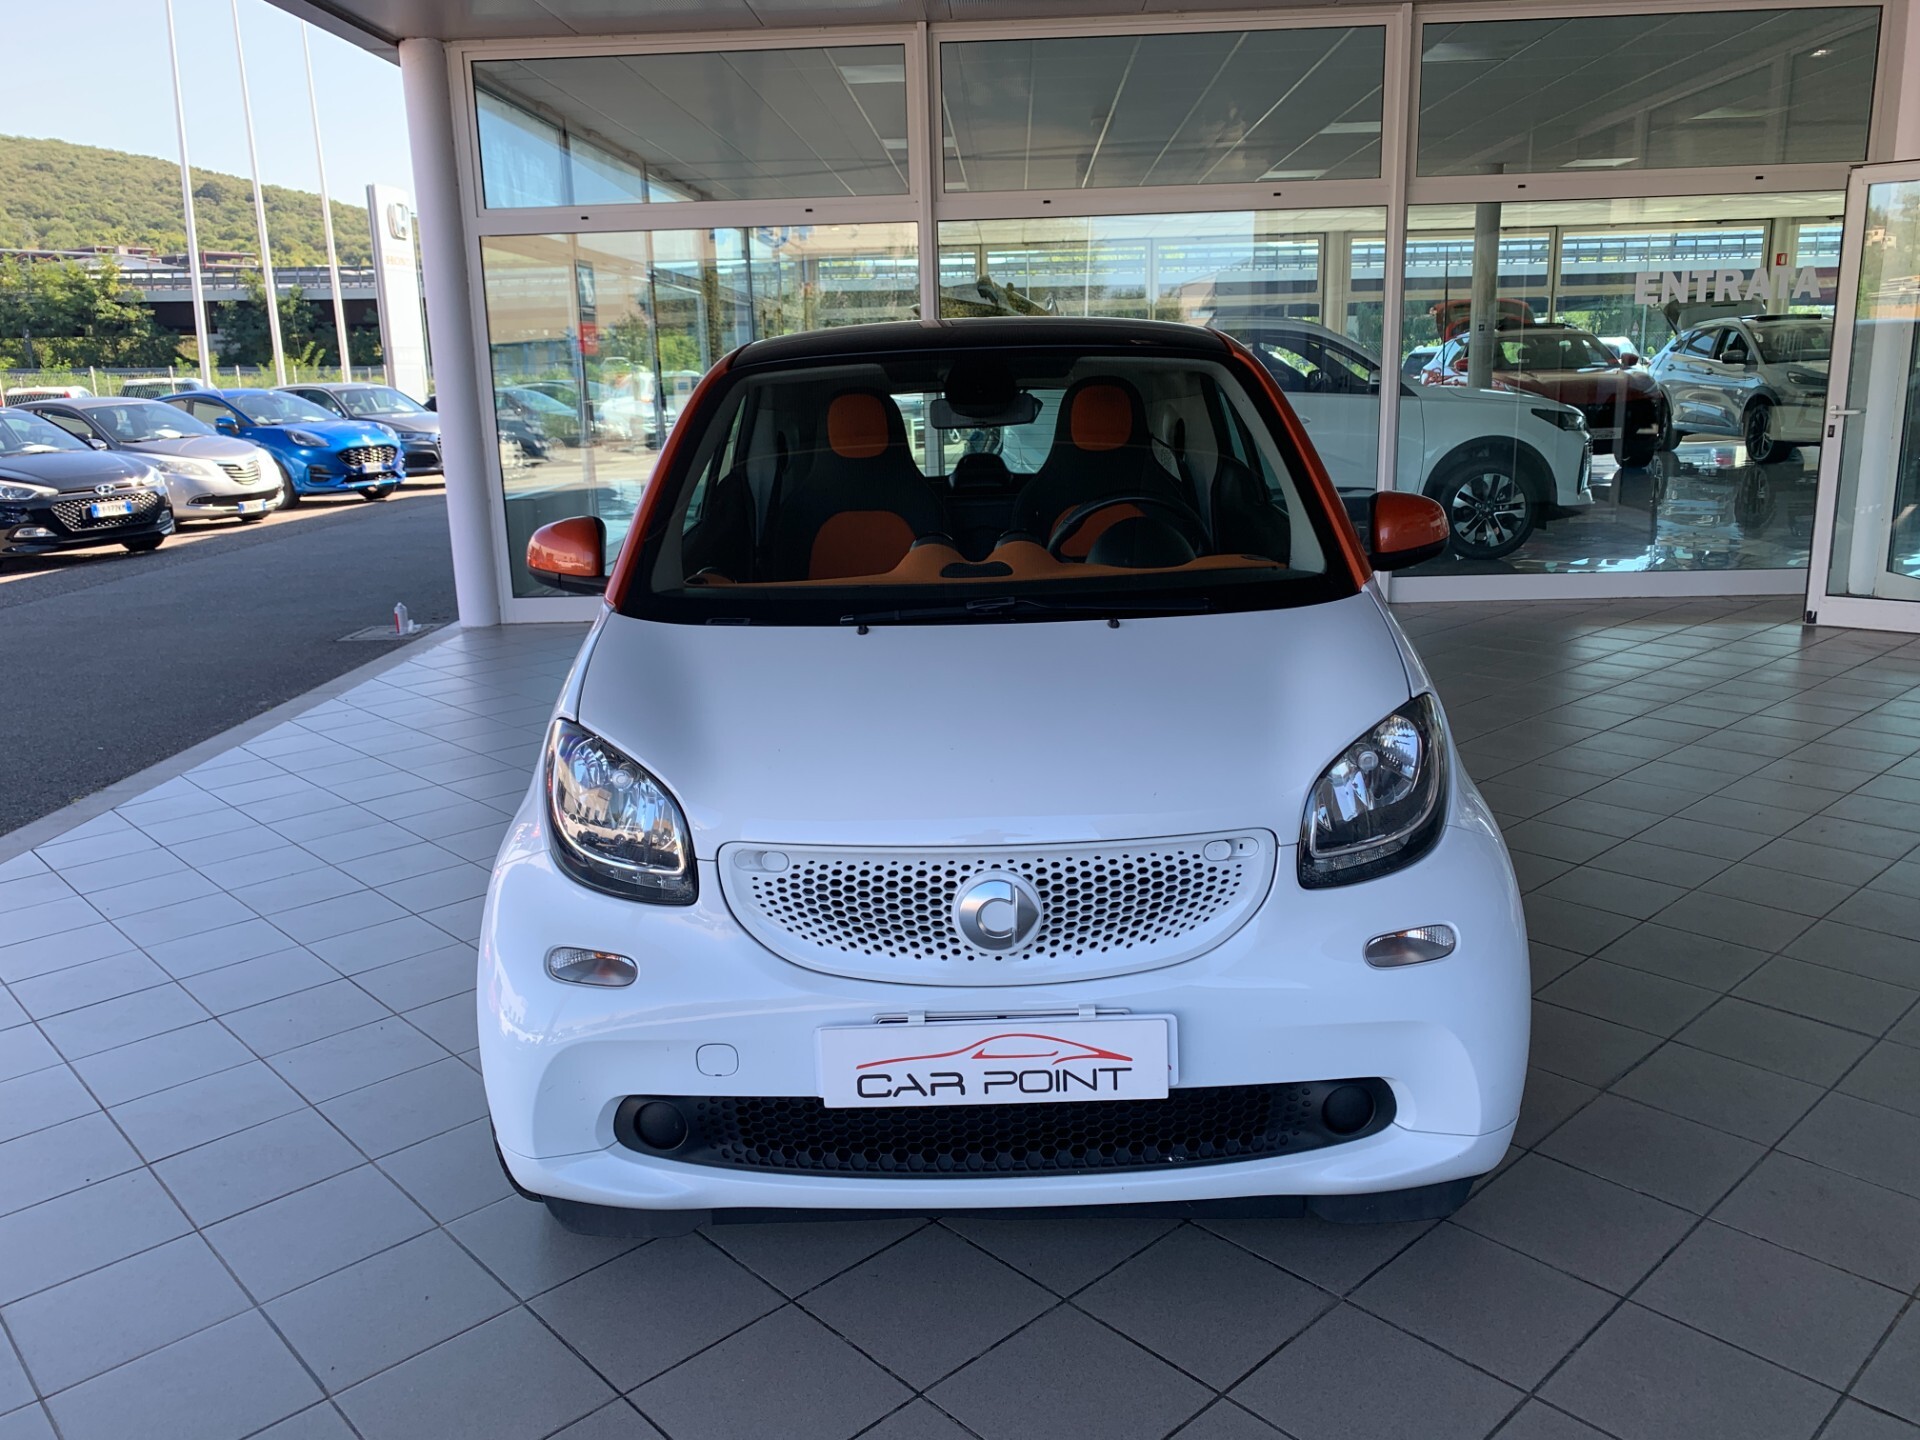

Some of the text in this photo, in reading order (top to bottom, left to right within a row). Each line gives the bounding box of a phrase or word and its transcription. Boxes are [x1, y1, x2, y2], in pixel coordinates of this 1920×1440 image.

[1634, 266, 1821, 304] ENTRATA
[856, 1067, 1133, 1098] CAR POINT
